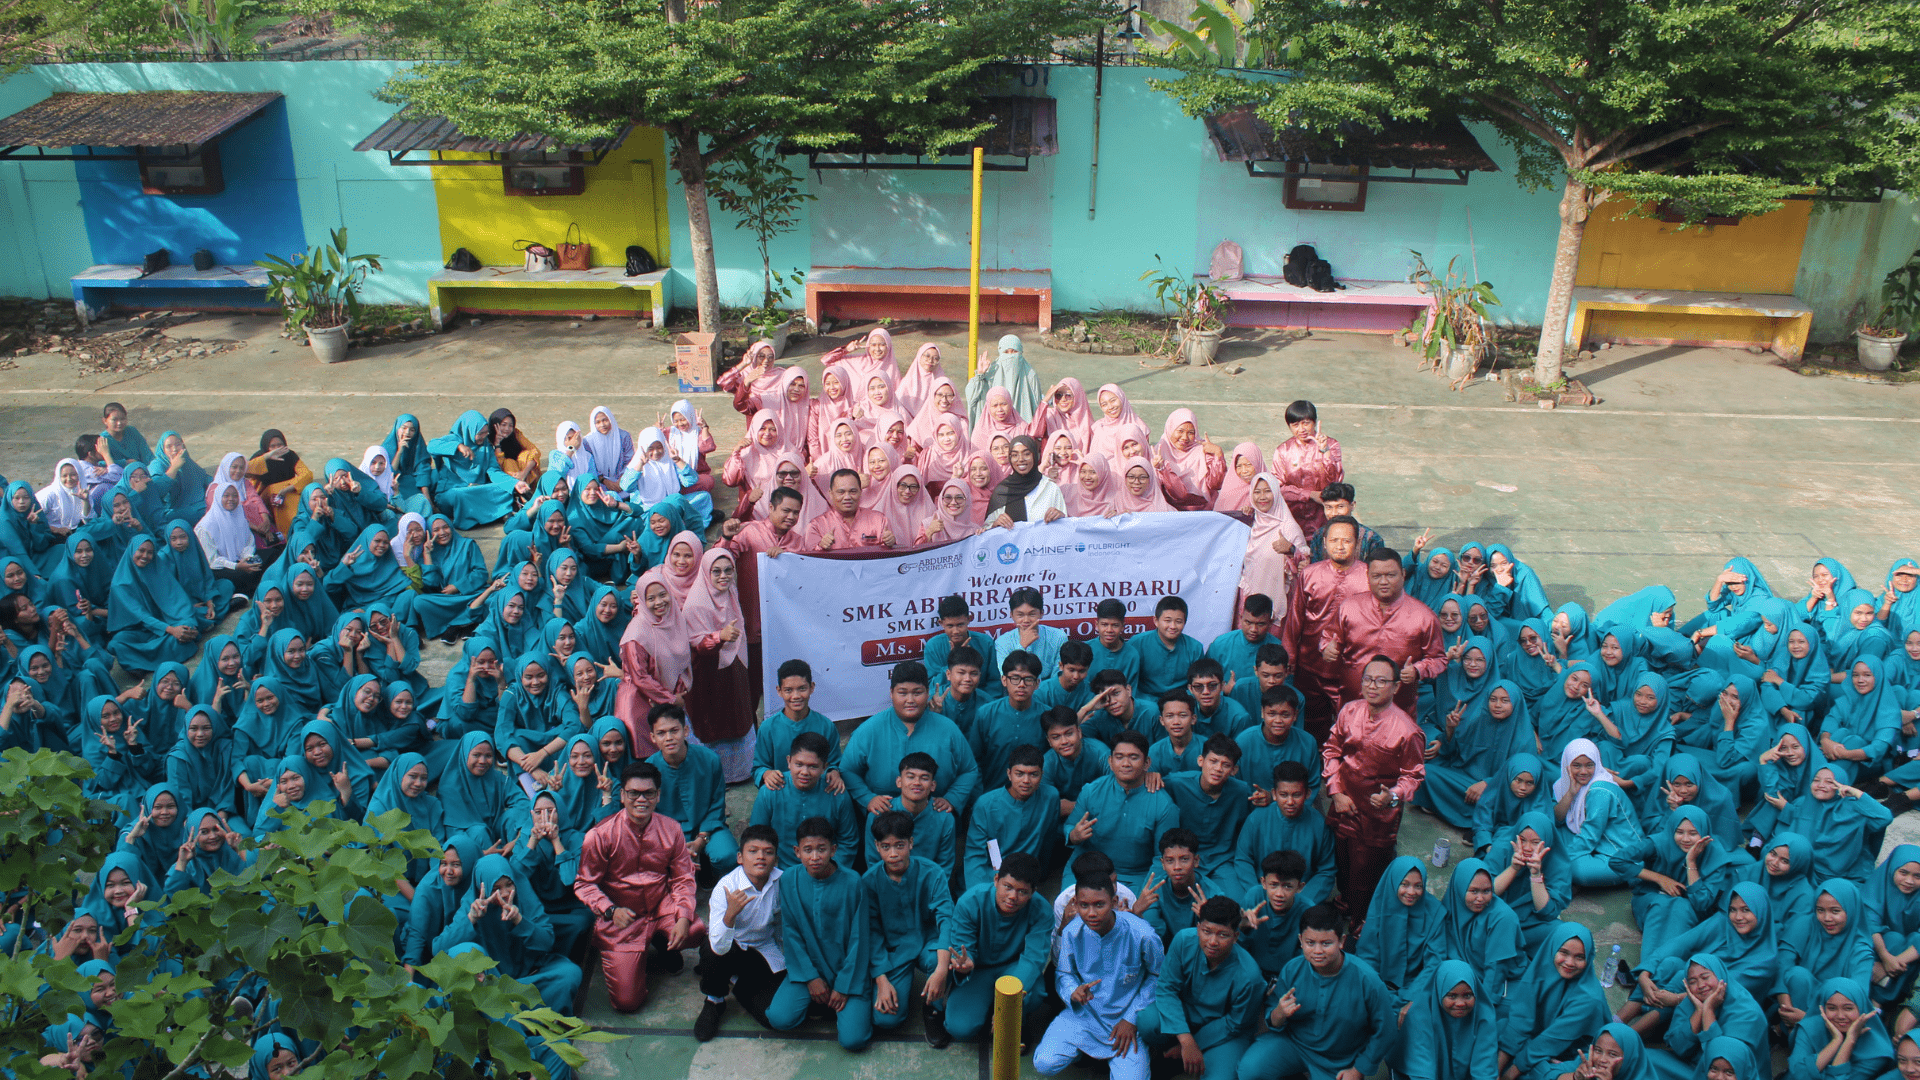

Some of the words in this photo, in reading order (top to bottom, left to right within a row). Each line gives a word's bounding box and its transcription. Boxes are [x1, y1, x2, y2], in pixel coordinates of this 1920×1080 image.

[1023, 545, 1073, 556] AMINEF
[1088, 542, 1131, 550] FULBRIGHT
[917, 560, 963, 573] FOUNDATION
[967, 572, 1036, 588] Welcome
[1039, 569, 1057, 582] To
[842, 602, 894, 623] SMK
[1038, 579, 1182, 599] PEKANBARU
[887, 618, 925, 634] SMK
[930, 606, 1012, 629] ROLUS
[1042, 601, 1099, 616] DUSTR
[875, 641, 912, 658] Ms.
